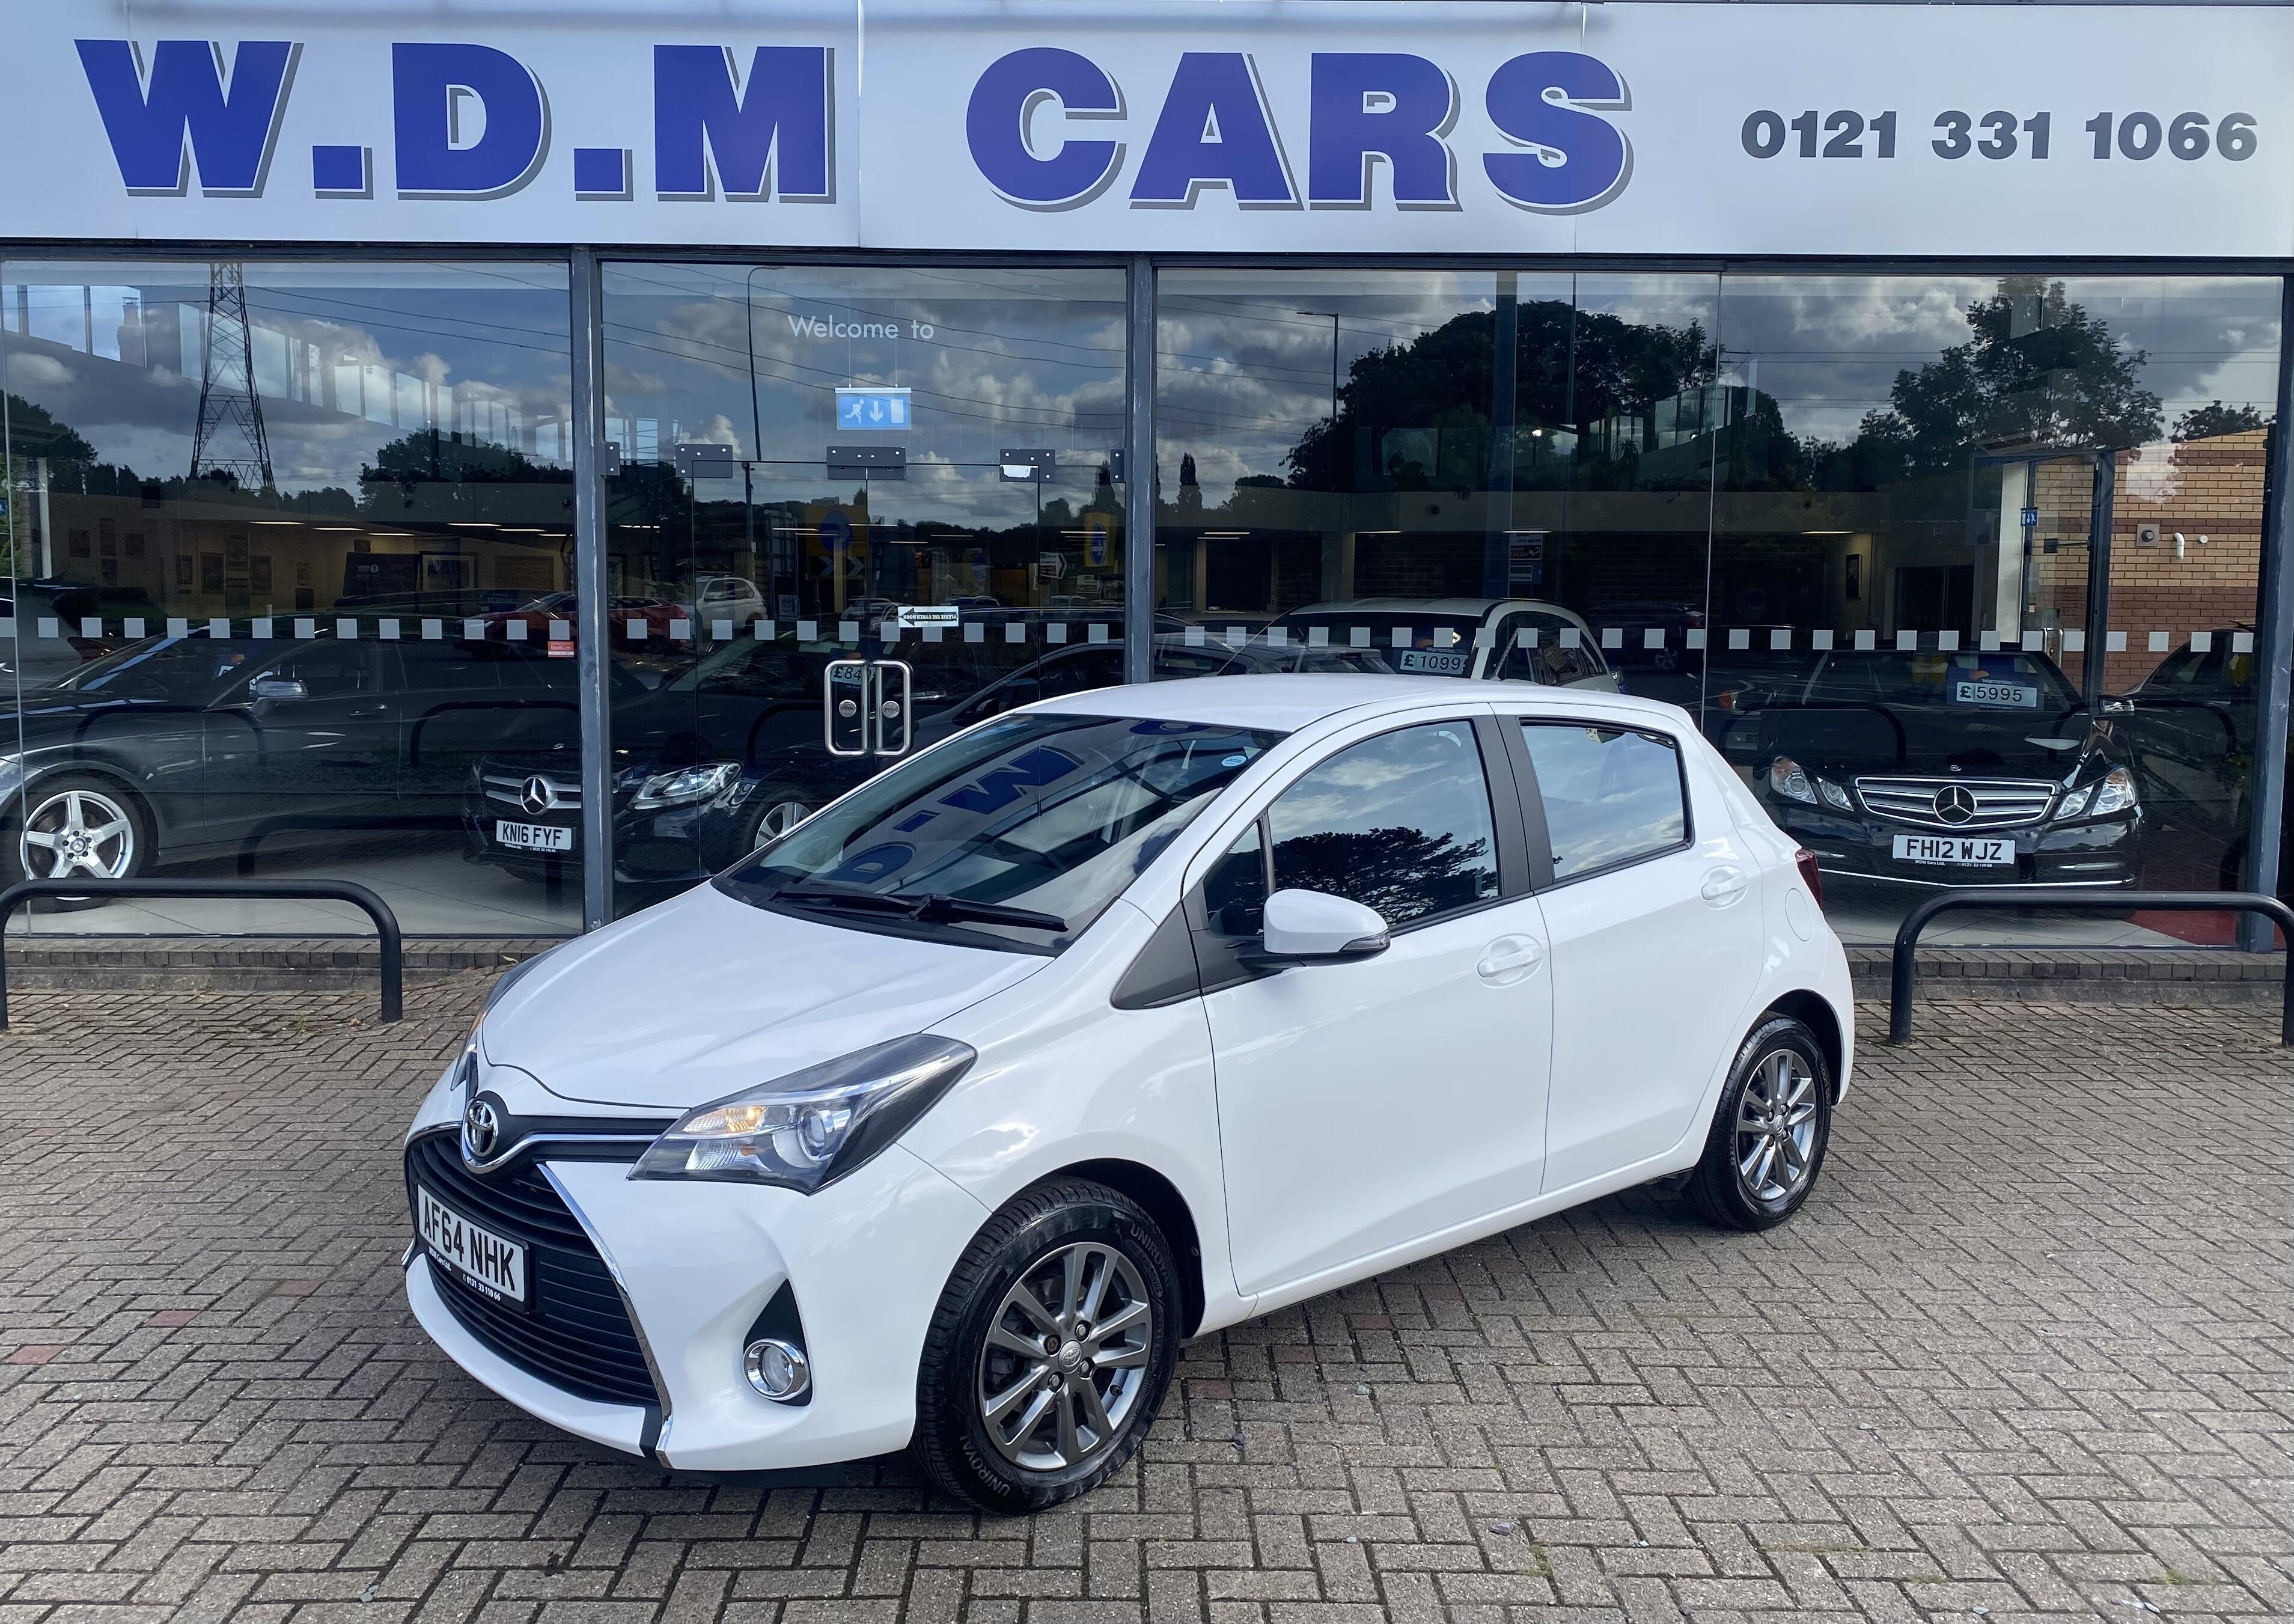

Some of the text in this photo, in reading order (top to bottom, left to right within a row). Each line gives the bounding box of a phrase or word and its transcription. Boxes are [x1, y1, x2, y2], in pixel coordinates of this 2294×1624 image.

[73, 39, 1634, 215] W.D.M CARS
[1741, 110, 2257, 161] 0121 331 1066
[787, 314, 935, 339] Welcome to
[834, 667, 875, 681] £84
[502, 823, 563, 846] KN16 FYF
[1906, 838, 2002, 861] FH12 WJZ
[424, 1195, 516, 1292] AF64 NHK
[466, 1275, 501, 1301] 0121 33 110 66
